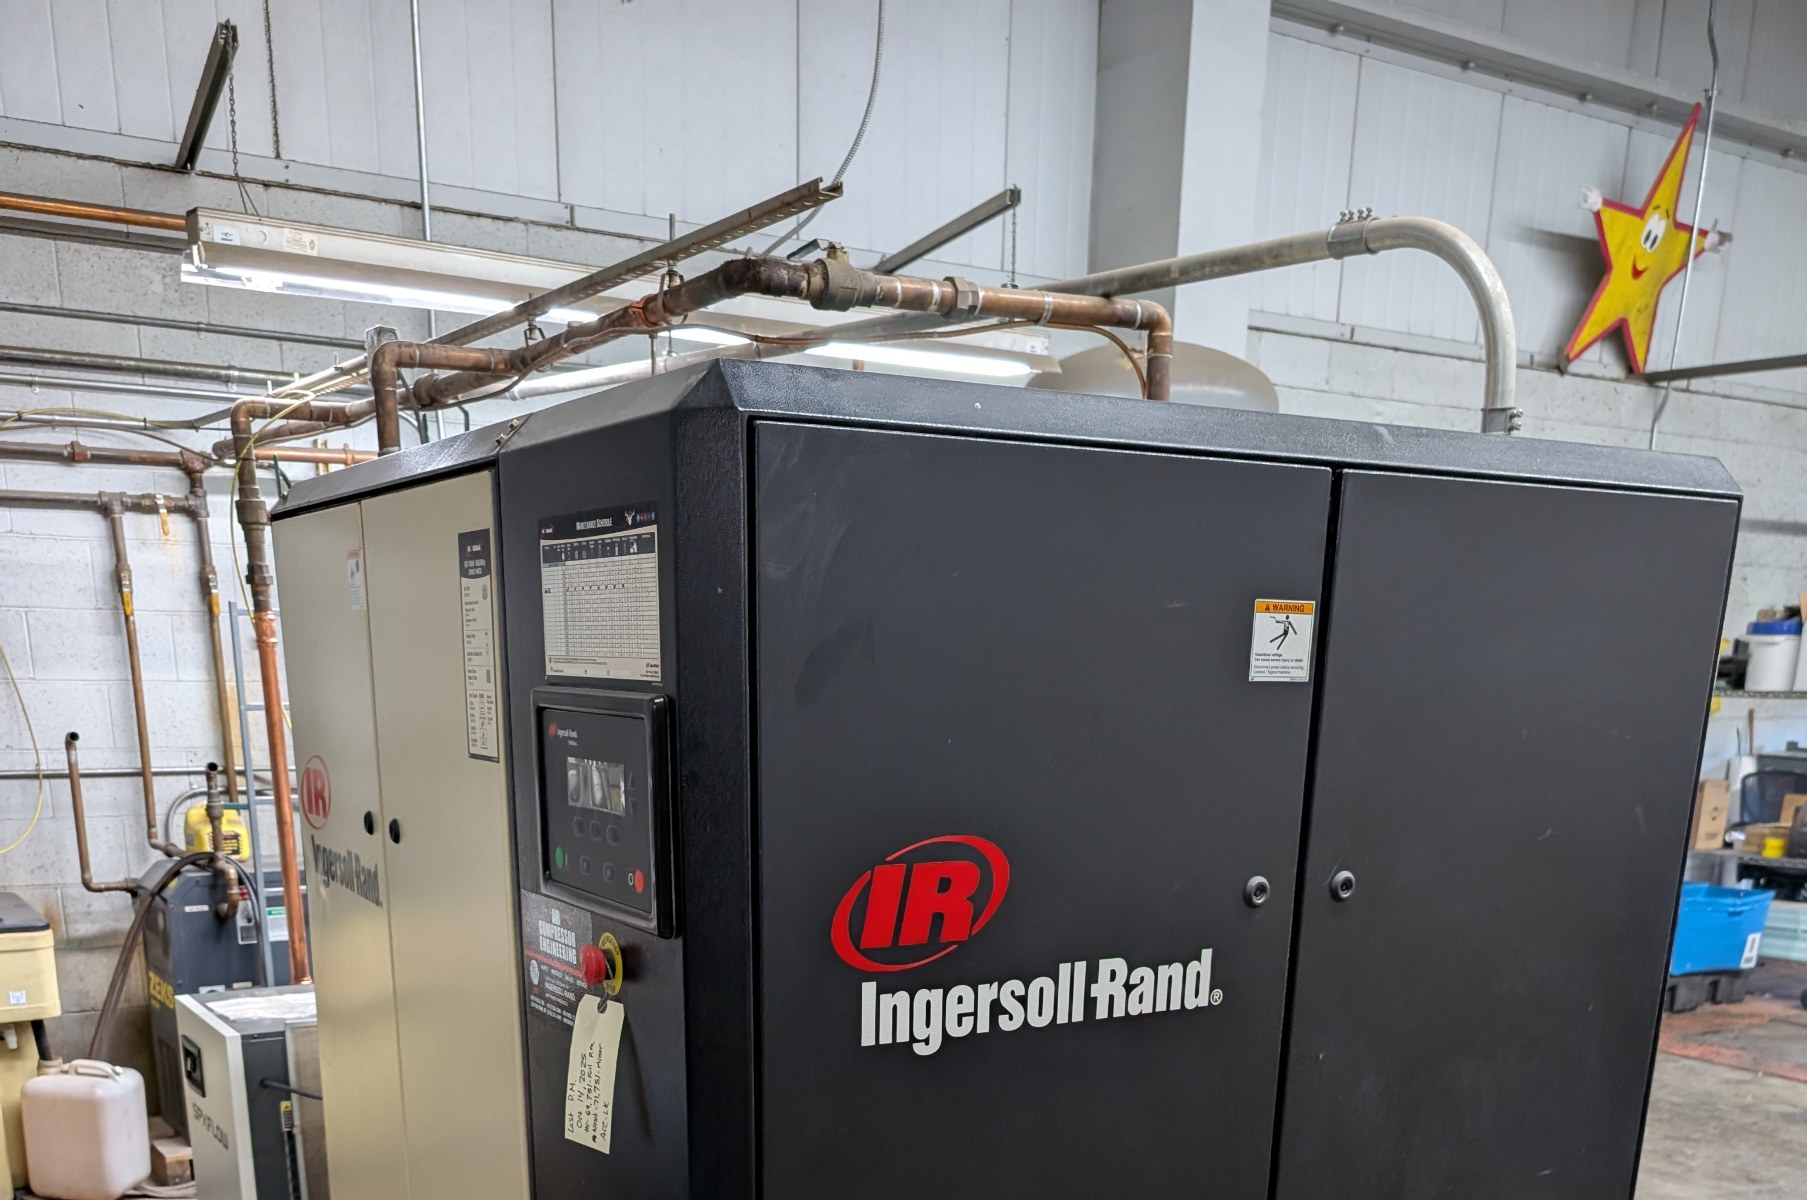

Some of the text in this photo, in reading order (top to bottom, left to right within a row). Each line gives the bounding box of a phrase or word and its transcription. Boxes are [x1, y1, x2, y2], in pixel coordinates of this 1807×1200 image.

[1272, 603, 1305, 612] WARNING
[310, 833, 355, 892] Ingersoll
[538, 919, 577, 949] COMPRESSOR
[539, 934, 578, 965] ENGINEERING
[149, 971, 175, 1009] ZEKS
[860, 960, 1088, 1057] Ingersoll
[578, 1052, 587, 1084] 2025
[567, 1112, 575, 1133] Last
[576, 1111, 584, 1128] Oct
